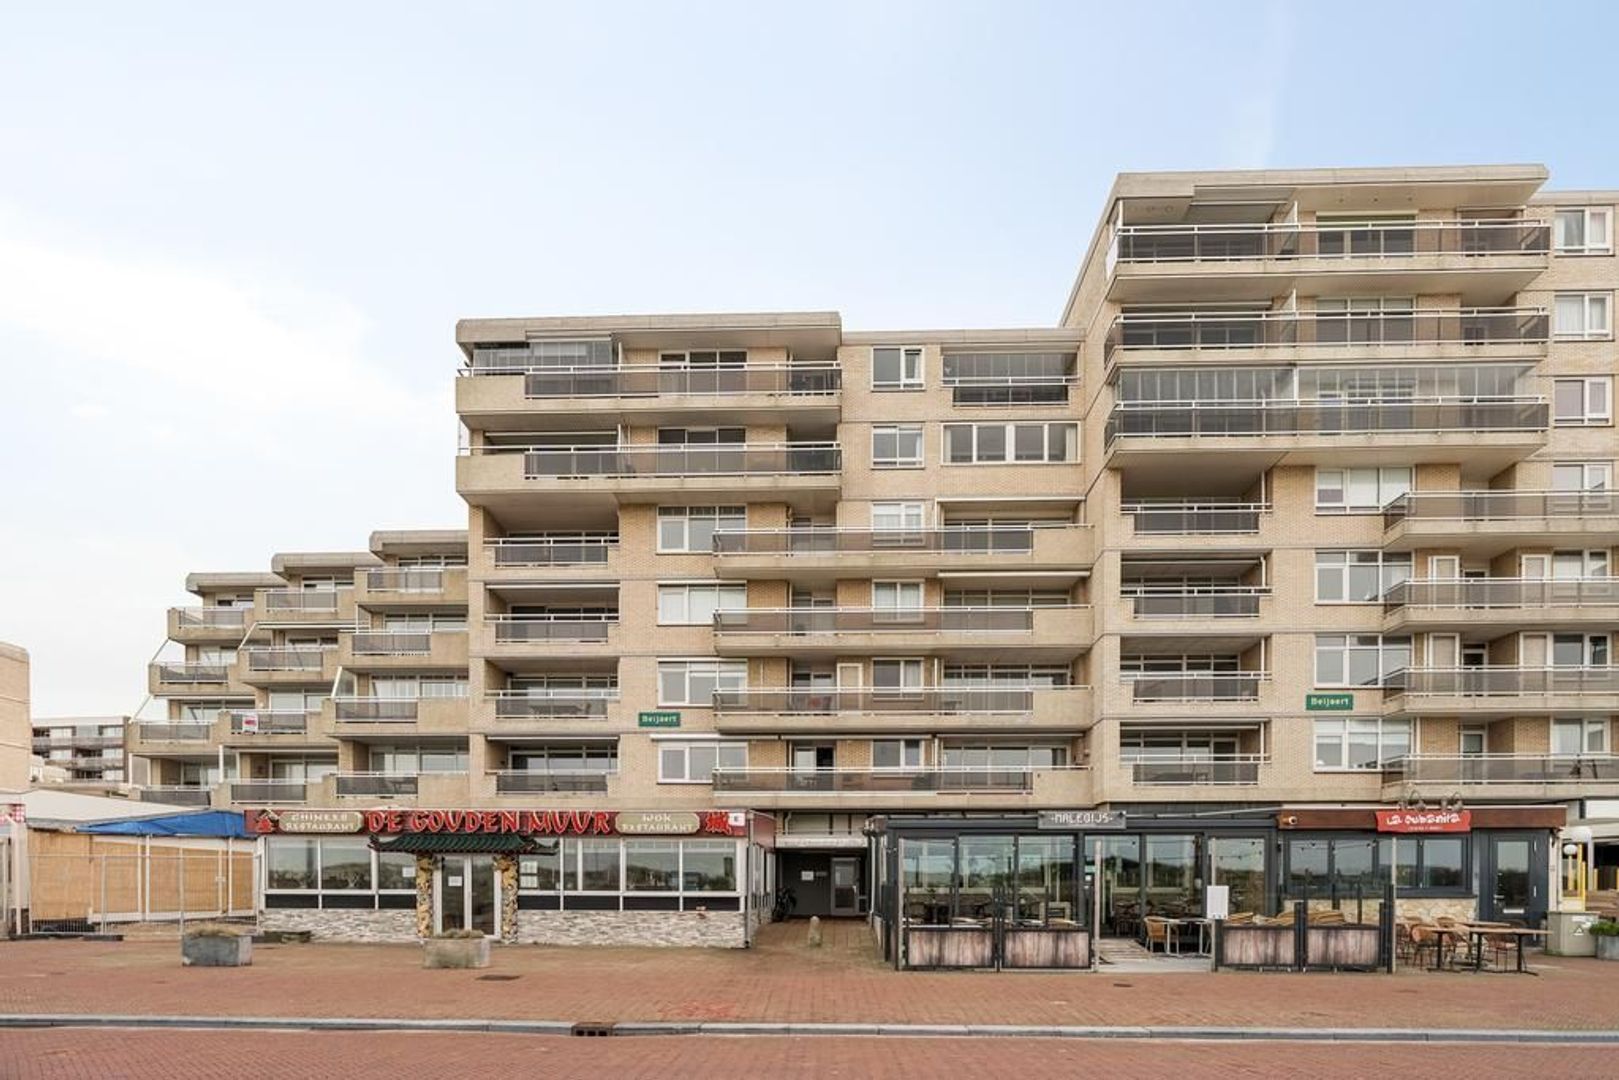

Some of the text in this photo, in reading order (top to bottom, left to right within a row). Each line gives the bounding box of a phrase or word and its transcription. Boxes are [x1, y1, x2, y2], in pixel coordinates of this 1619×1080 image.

[366, 810, 610, 833] DE GOUDEN MUUR
[642, 812, 672, 822] WOK
[286, 822, 354, 832] RESTAURANT
[621, 823, 693, 832] RESTAURANT
